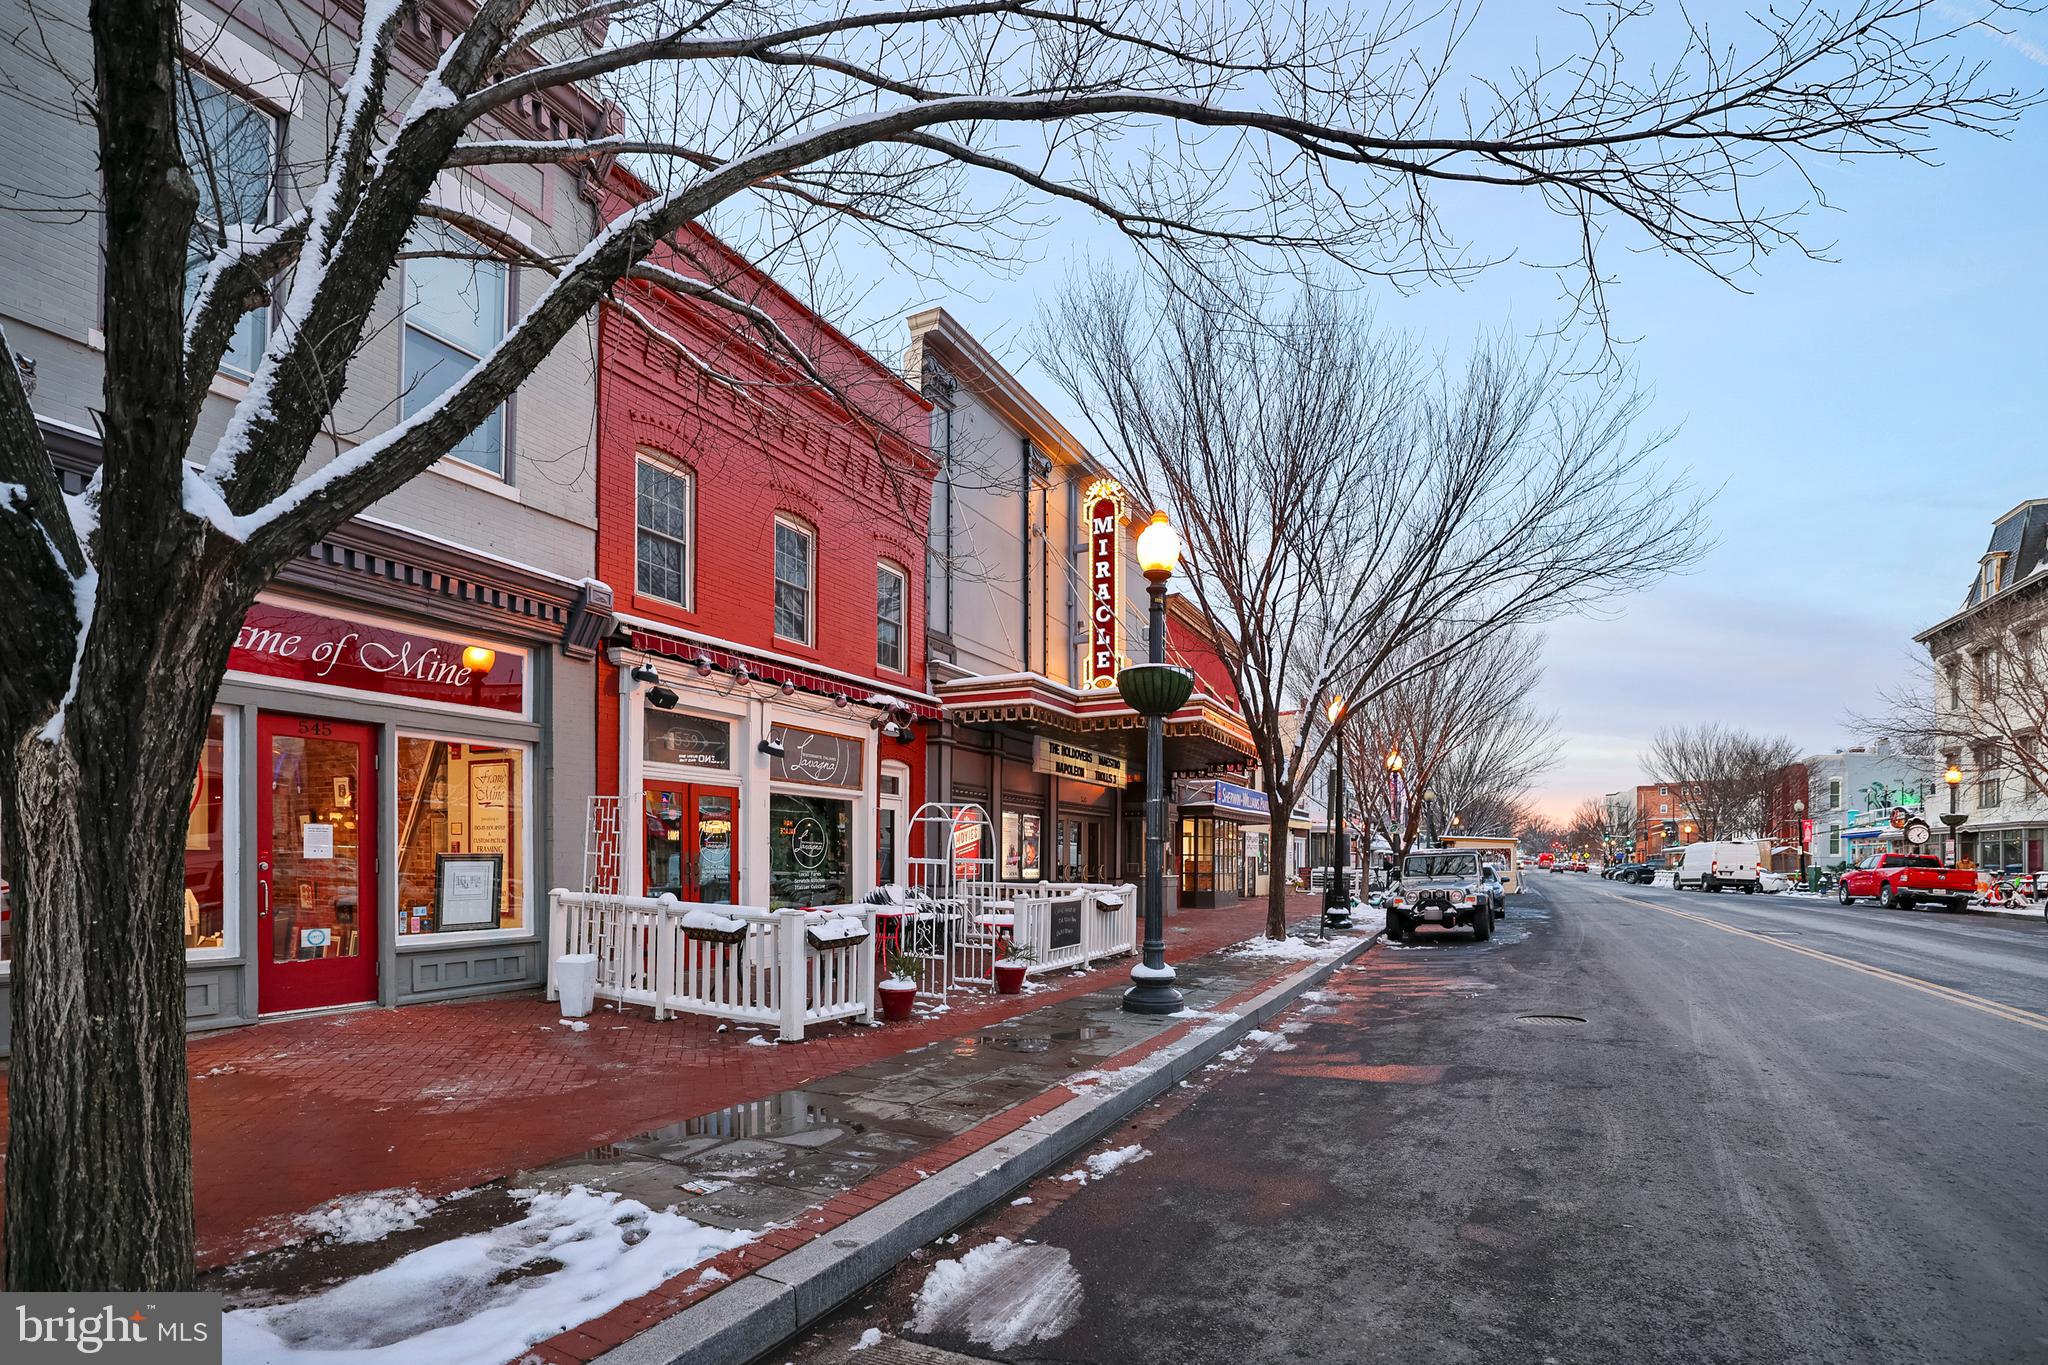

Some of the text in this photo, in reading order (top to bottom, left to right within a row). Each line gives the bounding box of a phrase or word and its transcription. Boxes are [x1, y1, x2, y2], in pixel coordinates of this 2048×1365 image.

[1092, 515, 1114, 669] MIRACLE
[312, 633, 359, 677] of
[360, 641, 472, 687] Mine
[298, 720, 333, 736] 545
[791, 734, 836, 780] Lavagna
[1049, 742, 1121, 769] THE HOLDOVERS MAESTRO
[1055, 762, 1085, 777] NAPOLEON
[1095, 770, 1112, 783] TROLLS
[475, 787, 505, 801] Mine
[476, 845, 503, 853] FRAMING
[955, 827, 979, 849] MOVIES
